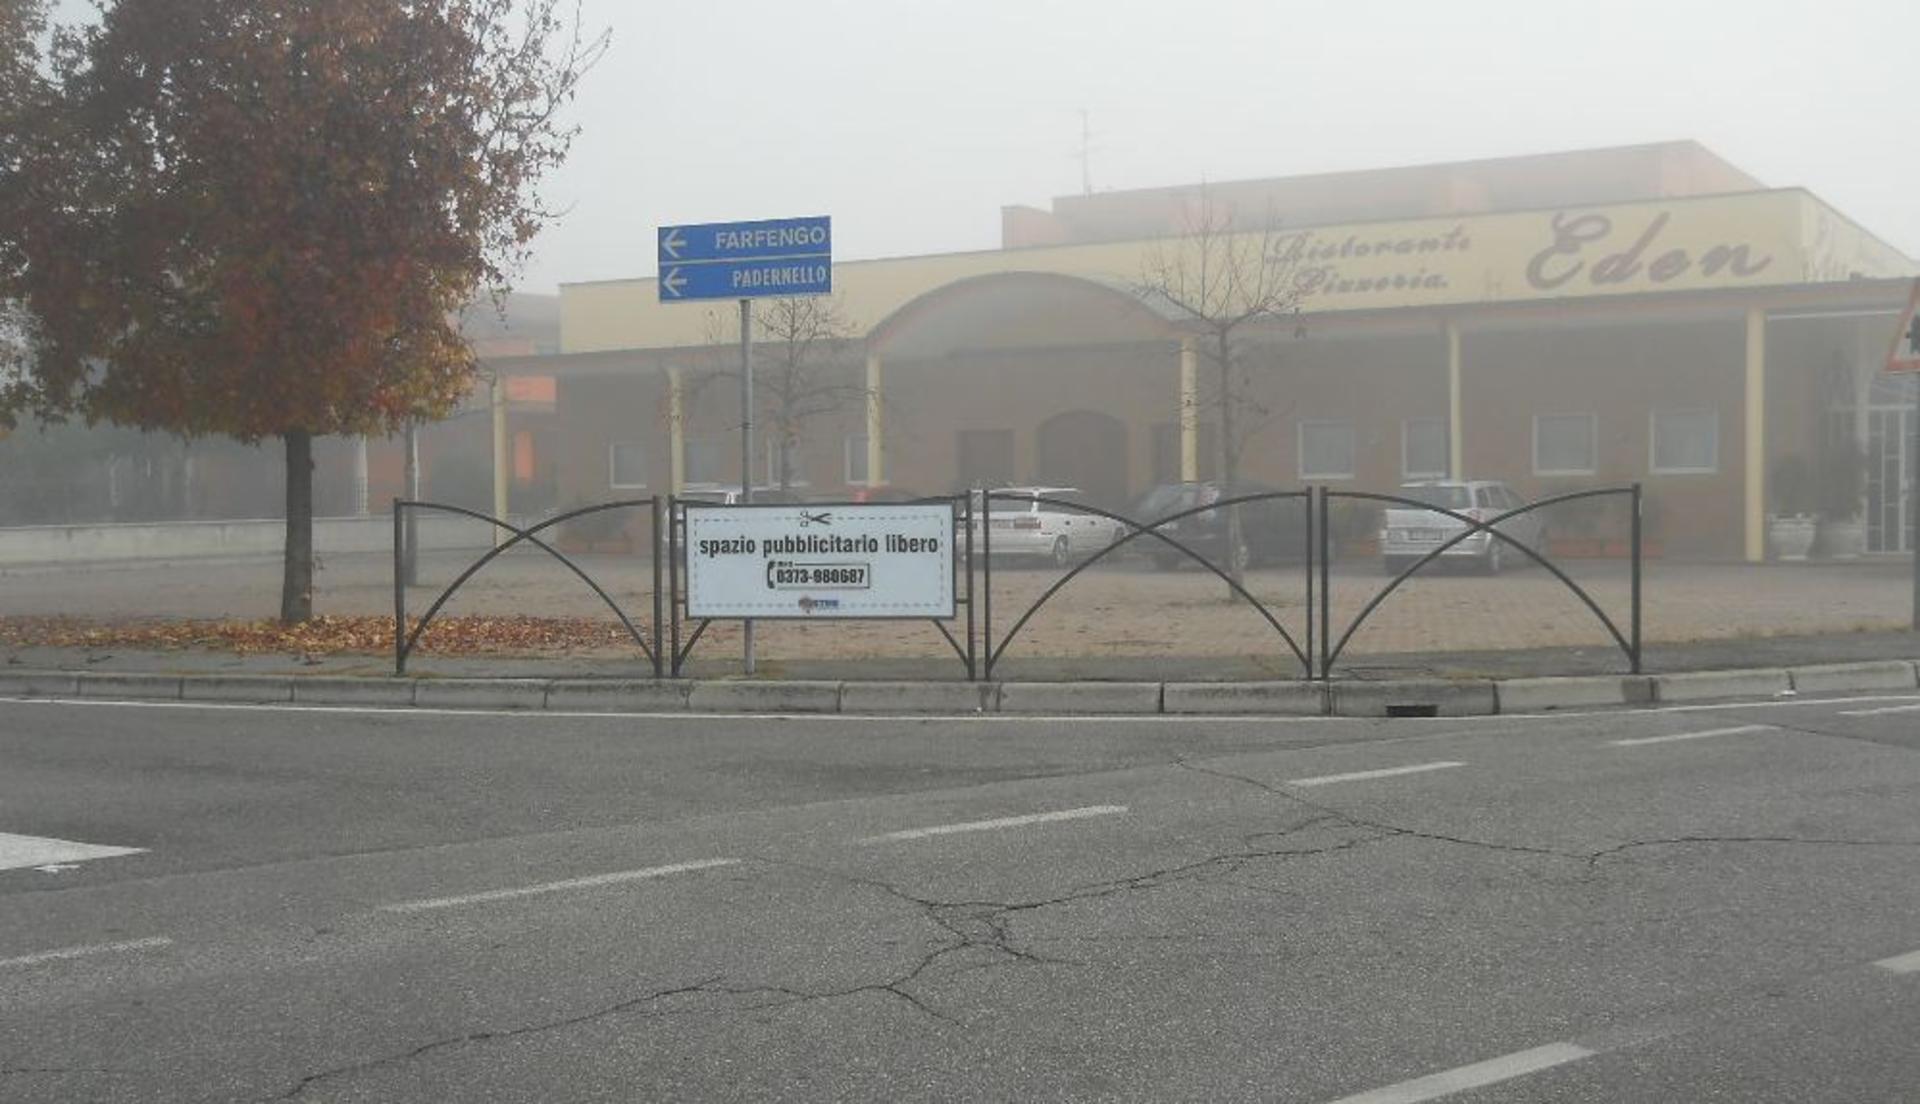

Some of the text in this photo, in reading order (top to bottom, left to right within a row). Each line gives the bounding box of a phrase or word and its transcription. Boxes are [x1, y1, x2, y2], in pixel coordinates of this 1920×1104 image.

[715, 226, 826, 249] FARFENGO
[1273, 224, 1471, 262] Ristorante
[1526, 211, 1772, 290] Eden
[732, 265, 826, 288] PADERNELLO
[699, 534, 938, 558] spazio pubblicitario libero
[776, 568, 865, 584] 0373-980687
